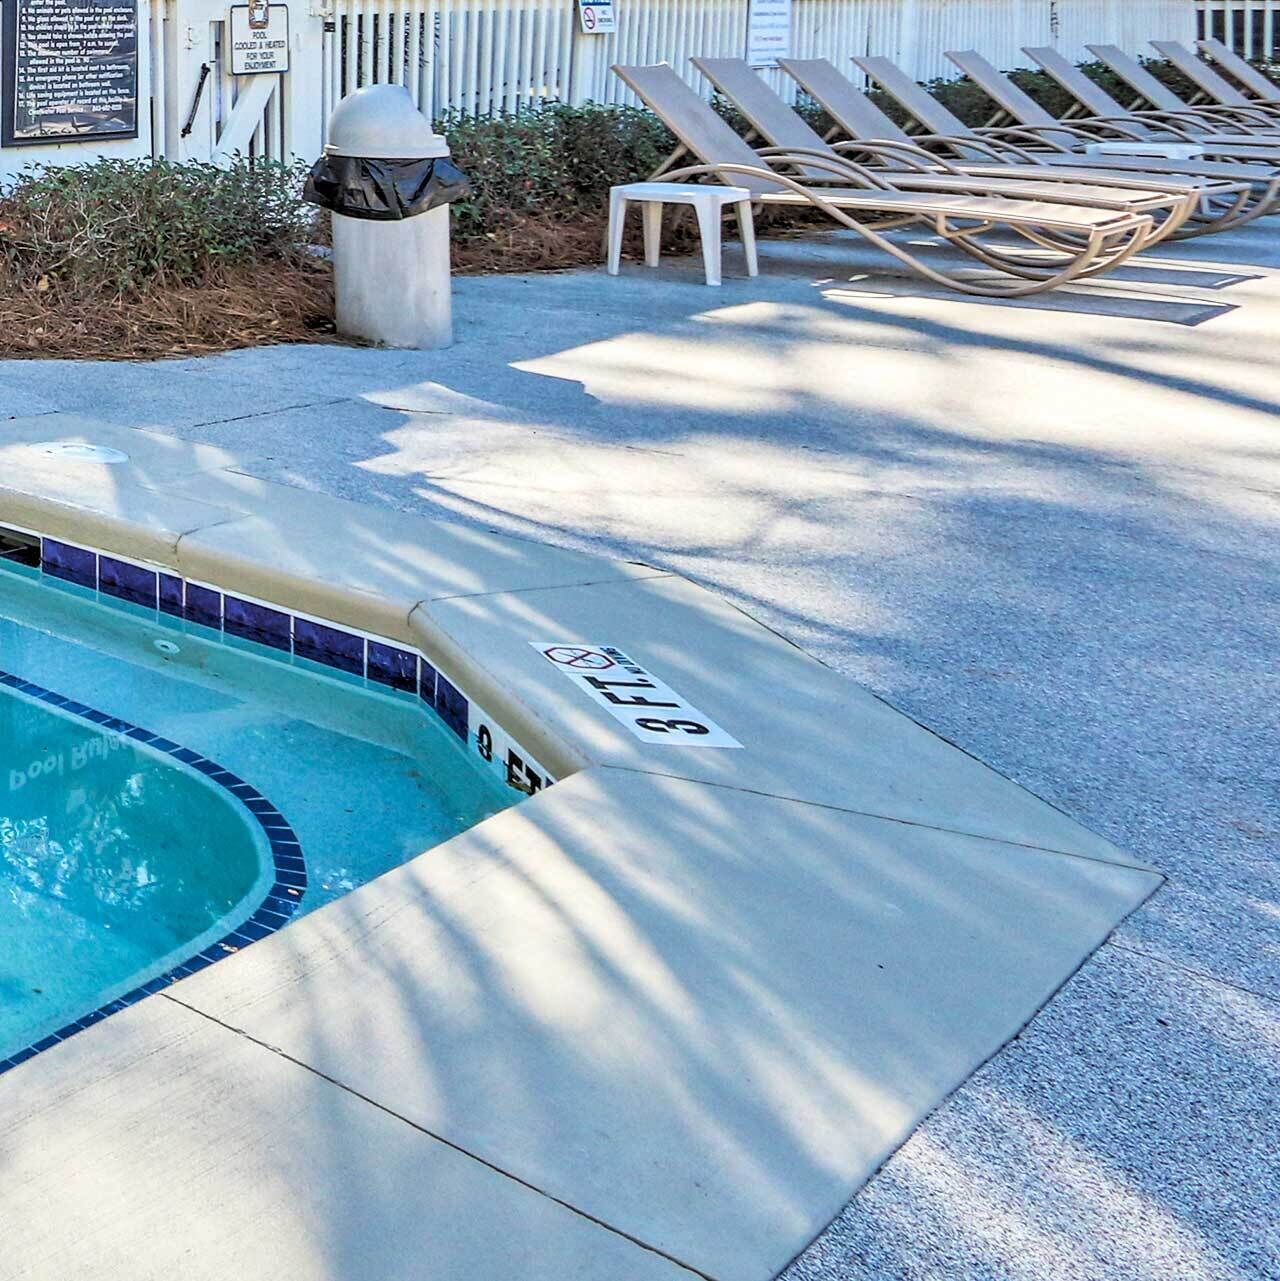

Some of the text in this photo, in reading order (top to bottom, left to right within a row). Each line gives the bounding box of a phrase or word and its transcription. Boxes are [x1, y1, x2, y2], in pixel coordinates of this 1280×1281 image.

[265, 40, 286, 49] HEATED
[246, 52, 258, 60] FOR
[244, 61, 277, 70] ENJOYMENT
[635, 717, 710, 735] 3
